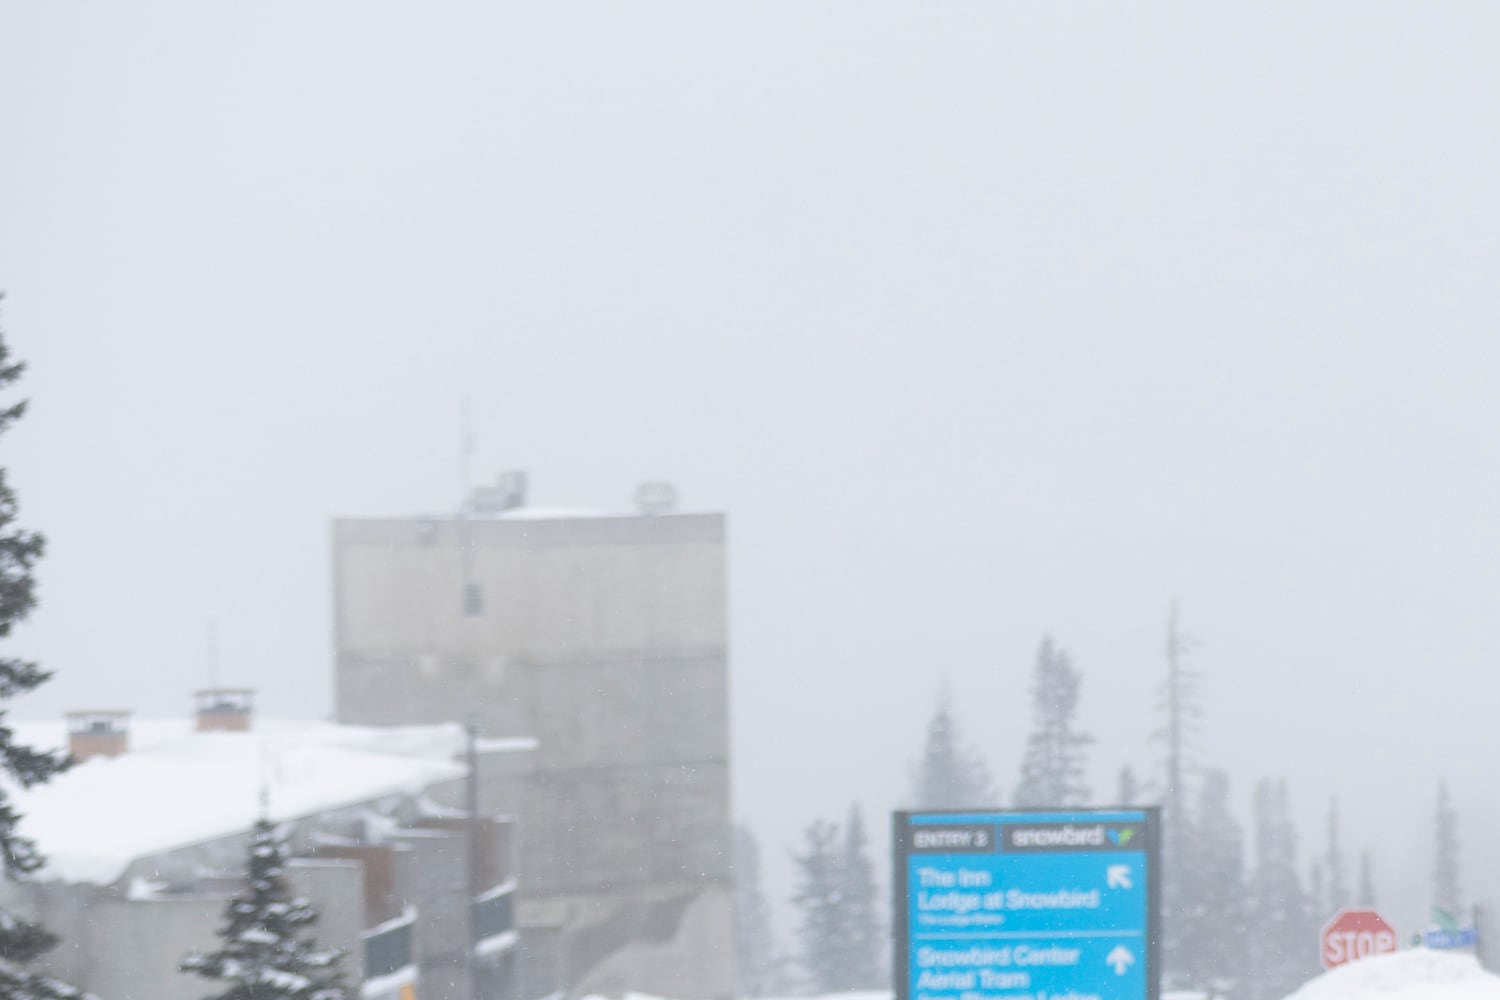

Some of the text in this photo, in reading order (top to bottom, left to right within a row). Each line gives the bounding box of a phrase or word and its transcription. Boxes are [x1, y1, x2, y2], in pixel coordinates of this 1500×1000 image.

[913, 830, 970, 848] ENTRY
[1011, 825, 1104, 847] snowbird
[917, 867, 992, 887] The Inn
[917, 888, 1100, 913] Lodge at Snowbird
[917, 945, 1080, 967] Snowbird Center
[1327, 931, 1393, 962] STOP
[917, 968, 1030, 989] Aerial Tram
